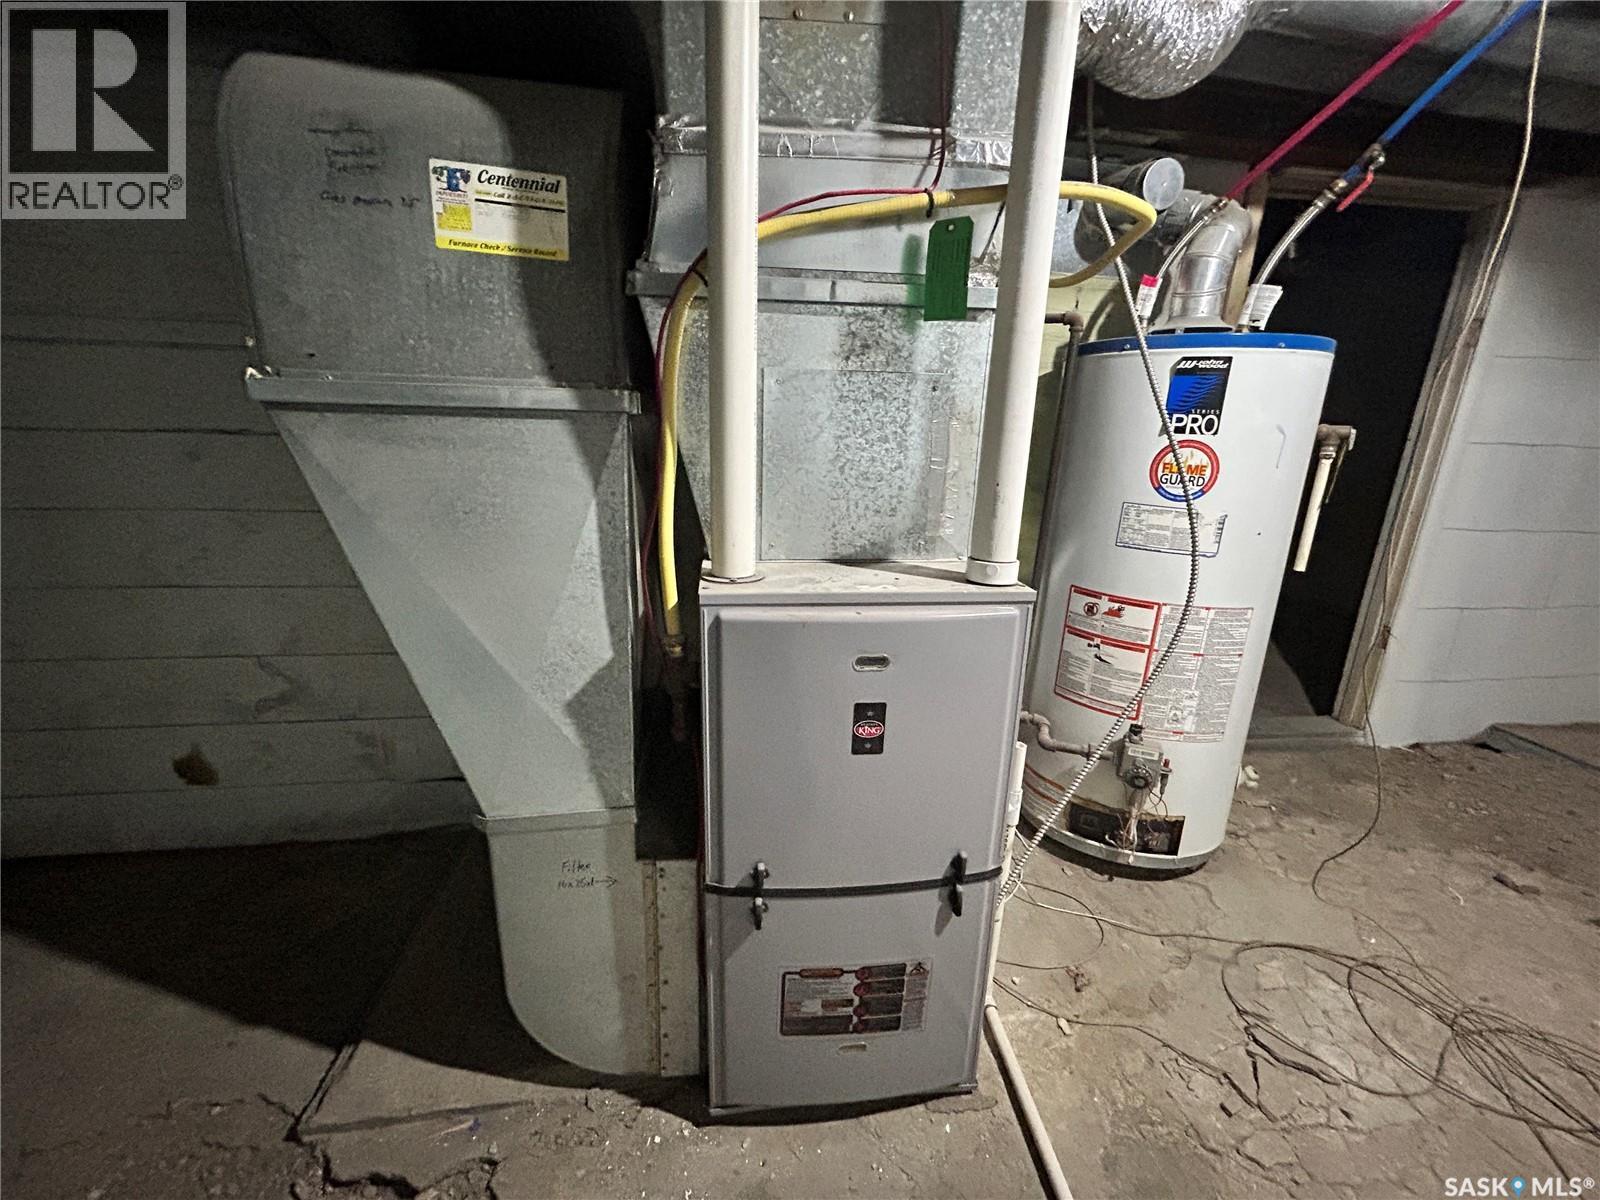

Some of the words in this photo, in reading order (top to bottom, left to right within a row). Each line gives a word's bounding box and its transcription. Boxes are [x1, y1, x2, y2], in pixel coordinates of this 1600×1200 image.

[477, 169, 561, 194] Centennial
[448, 239, 477, 249] Furnace
[479, 243, 501, 251] Check
[1171, 413, 1219, 435] PRO
[1162, 462, 1207, 476] FLME
[858, 726, 880, 736] KING
